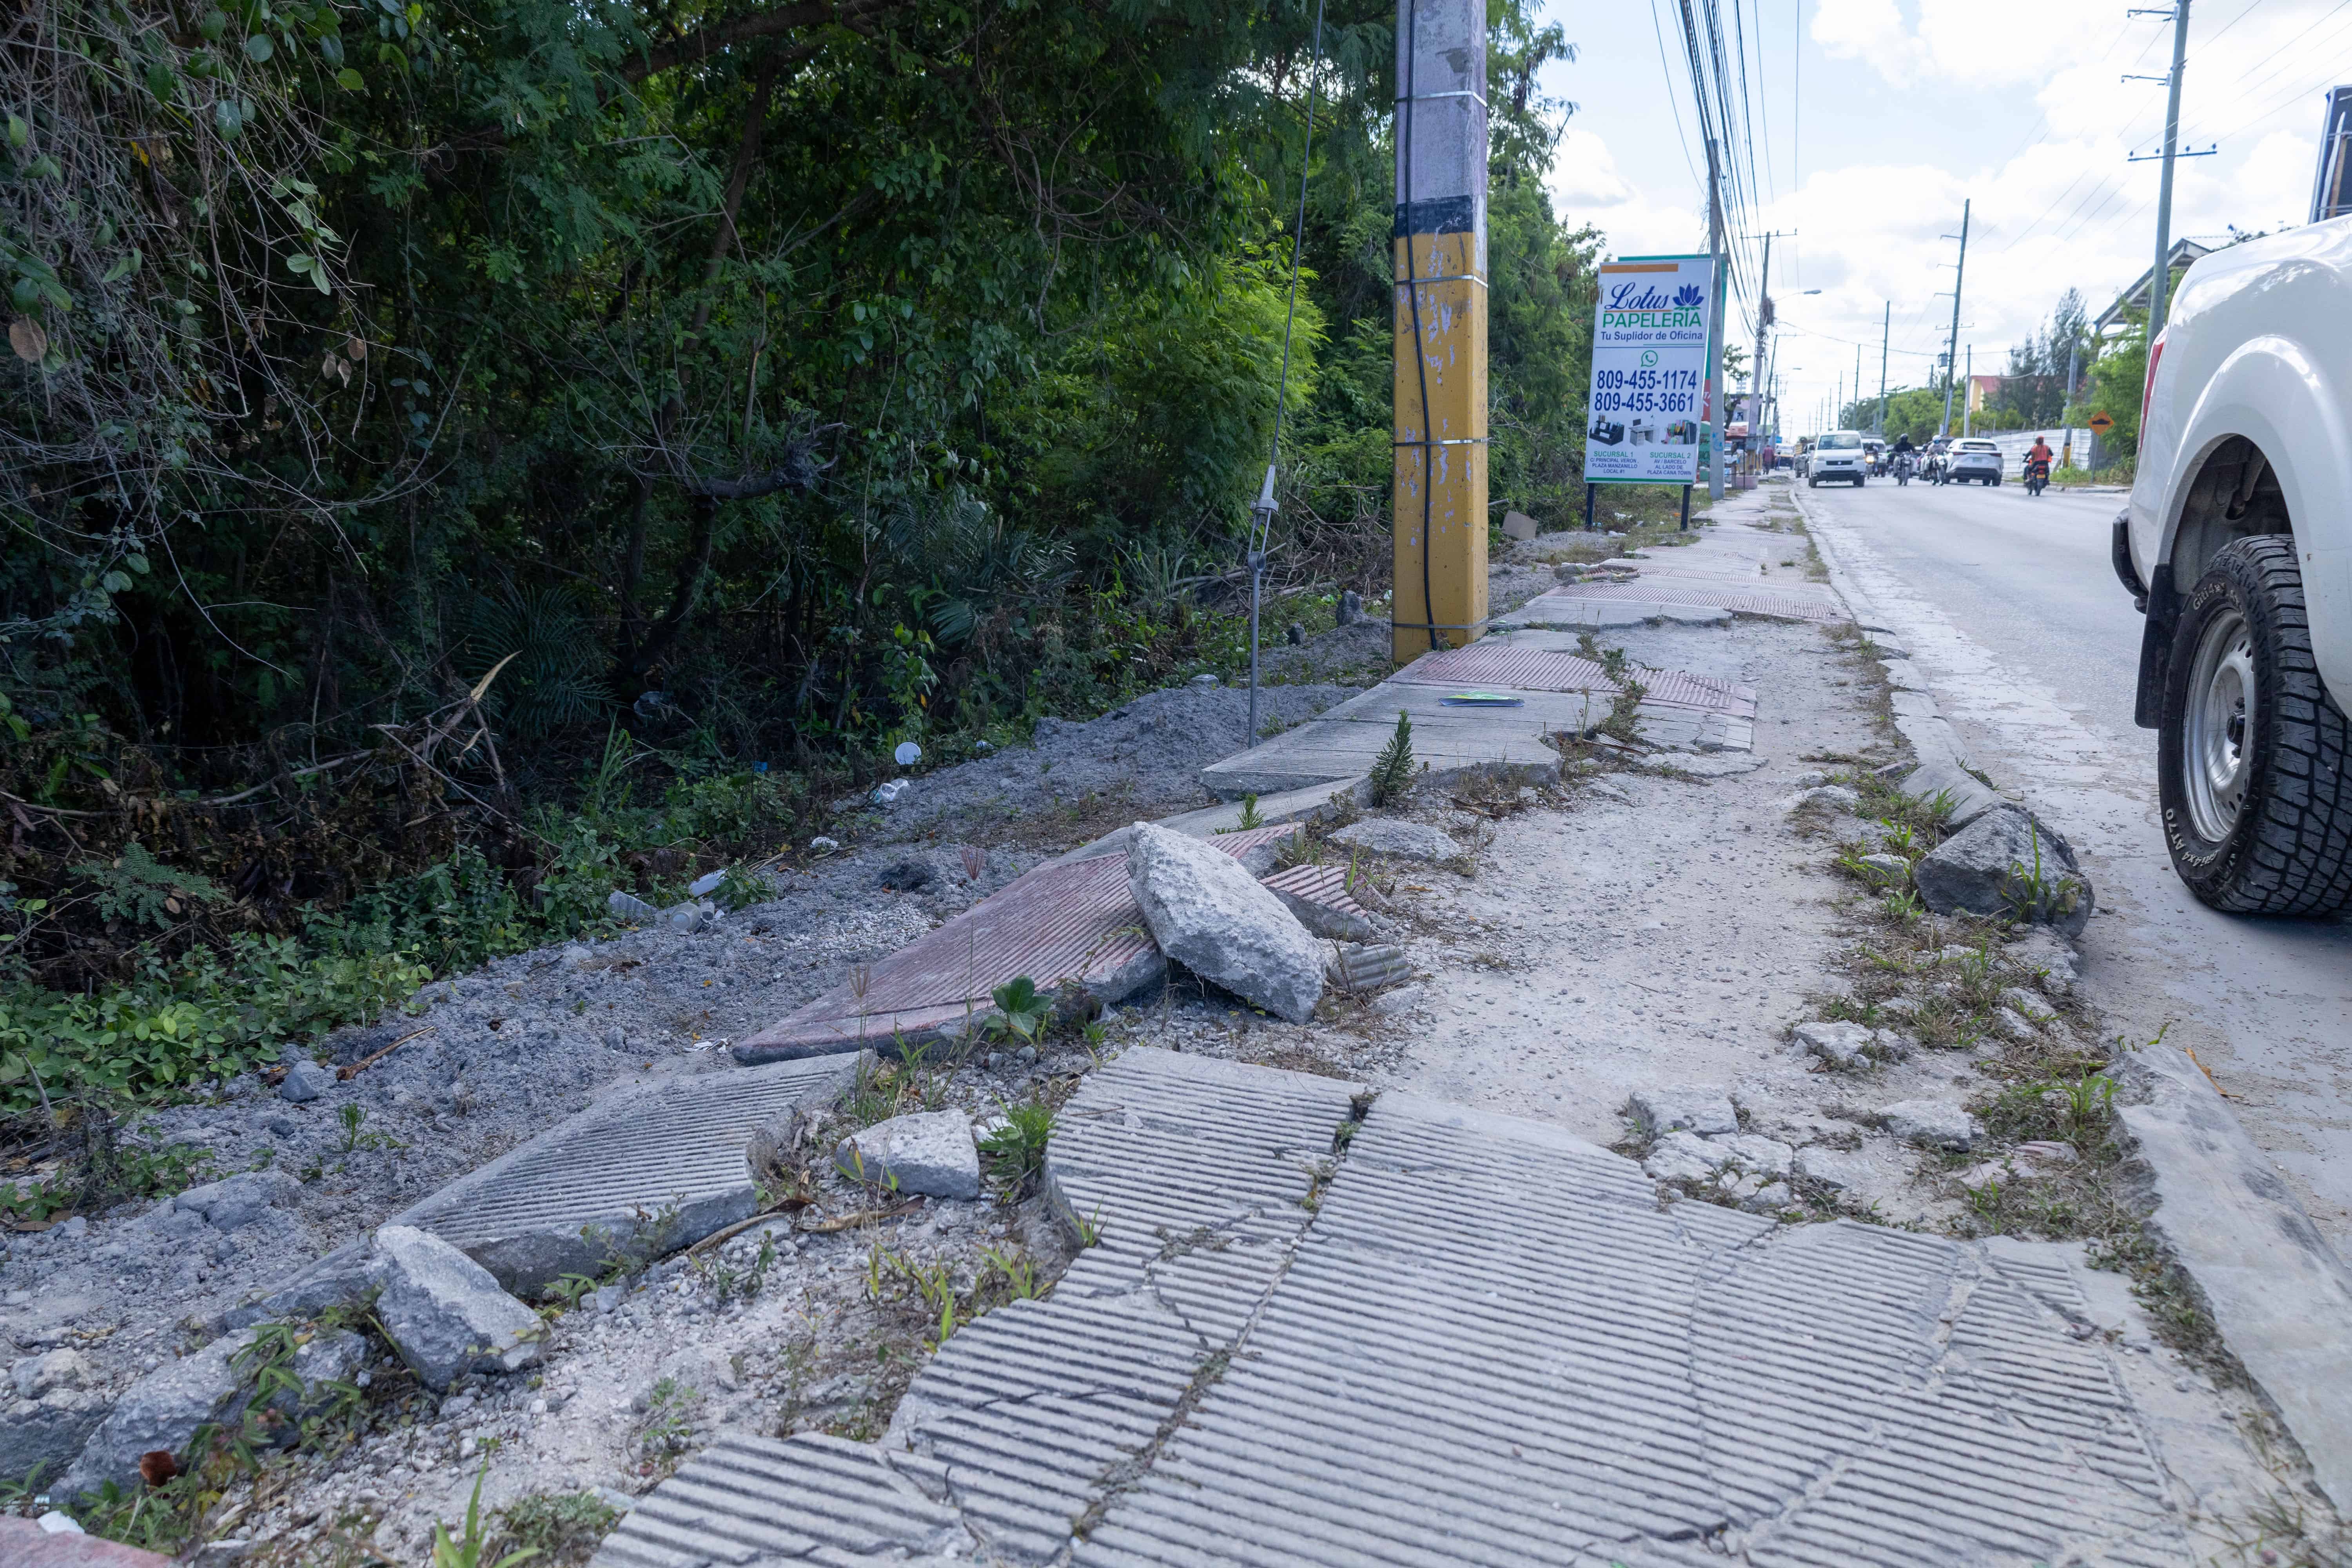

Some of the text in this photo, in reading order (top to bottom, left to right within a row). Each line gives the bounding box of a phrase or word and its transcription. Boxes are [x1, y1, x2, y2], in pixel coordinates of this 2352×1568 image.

[1604, 282, 1669, 309] Lotus
[1601, 332, 1611, 340] Tu
[1614, 332, 1653, 342] Suplidor
[1670, 331, 1702, 339] Oficina
[1597, 370, 1697, 389] 809-455-1174
[1595, 392, 1693, 412] 809-455-3661
[2166, 809, 2186, 850] AT70
